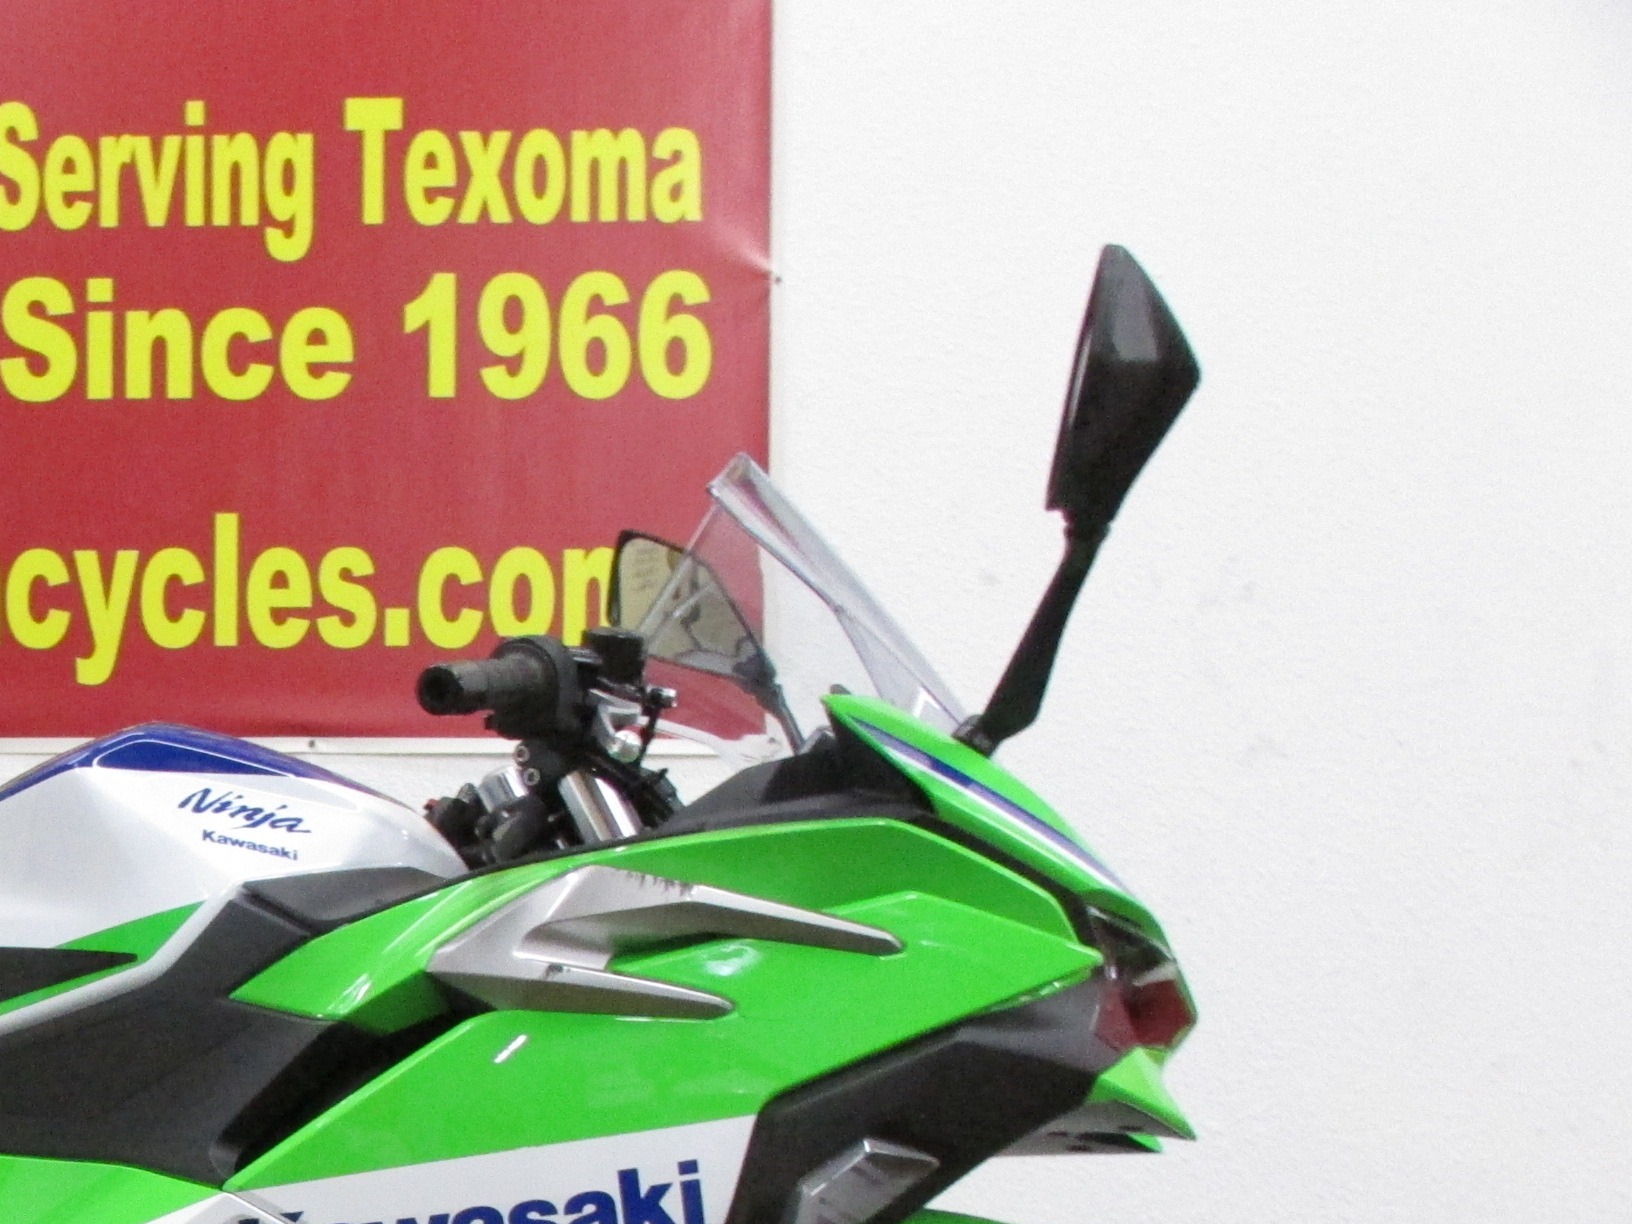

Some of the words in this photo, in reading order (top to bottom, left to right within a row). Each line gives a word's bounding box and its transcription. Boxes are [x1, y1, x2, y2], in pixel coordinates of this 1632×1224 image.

[343, 97, 703, 227] Texoma
[403, 270, 713, 401] 1966
[178, 787, 311, 833] Ninja
[202, 829, 298, 861] Kawasaki
